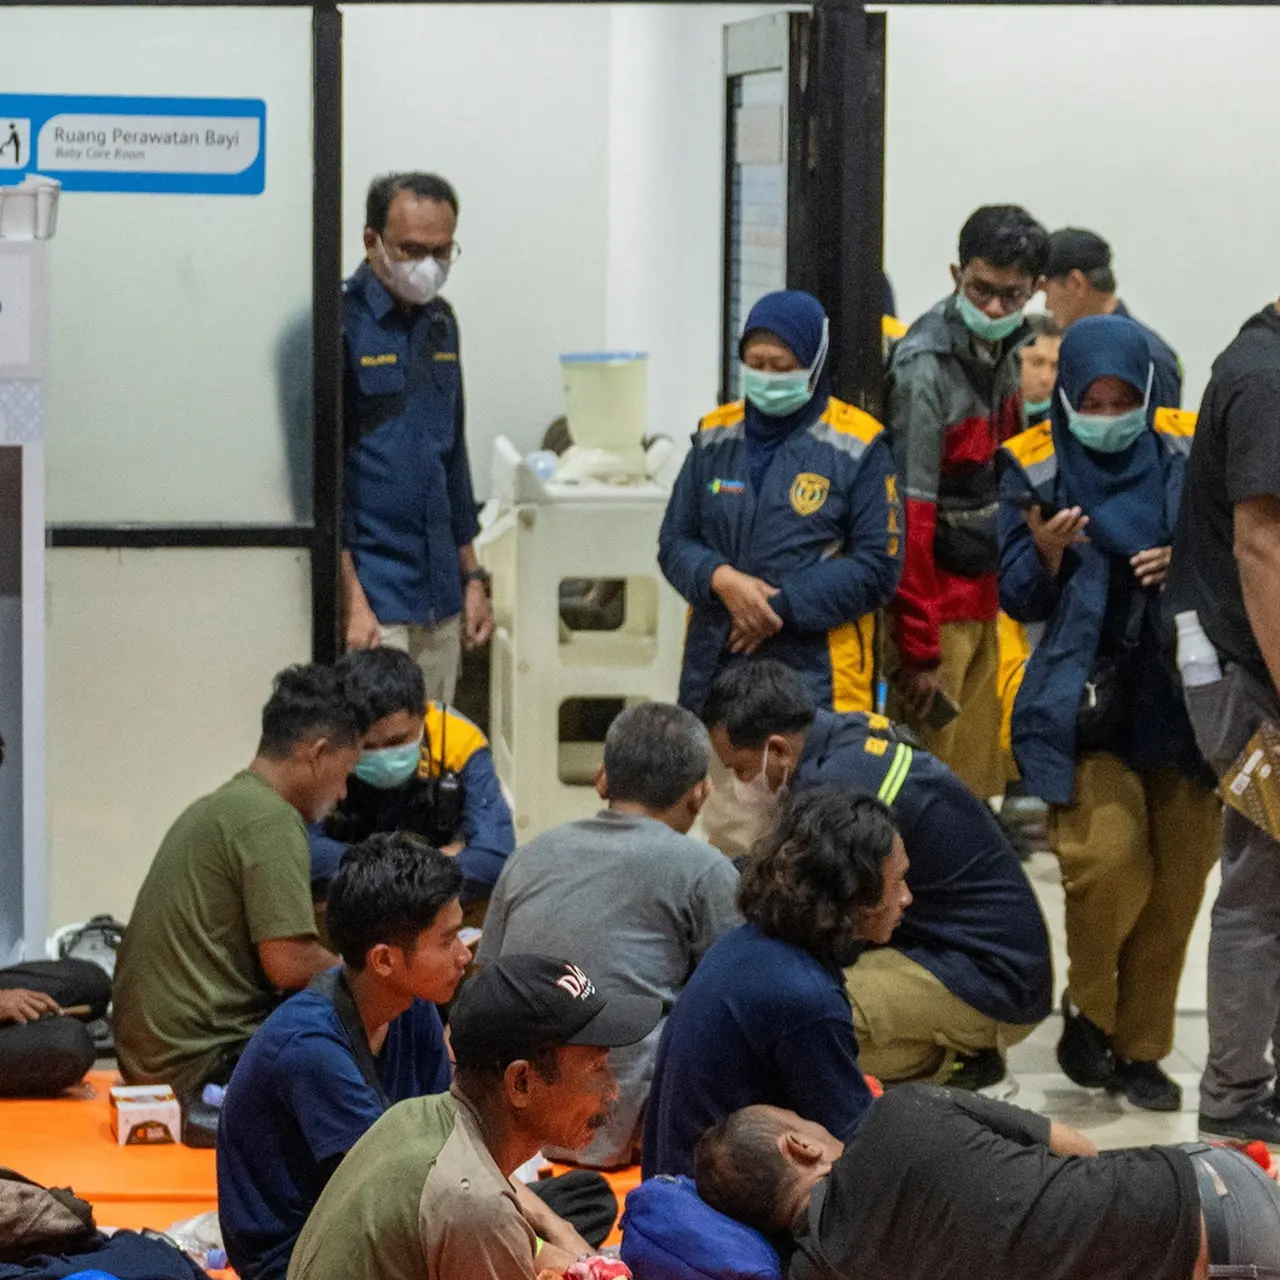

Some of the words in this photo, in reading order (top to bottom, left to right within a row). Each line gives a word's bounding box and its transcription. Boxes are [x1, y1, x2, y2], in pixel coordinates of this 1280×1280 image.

[54, 127, 106, 147] Ruang
[112, 127, 199, 145] Perawatan
[205, 129, 240, 149] Bayi
